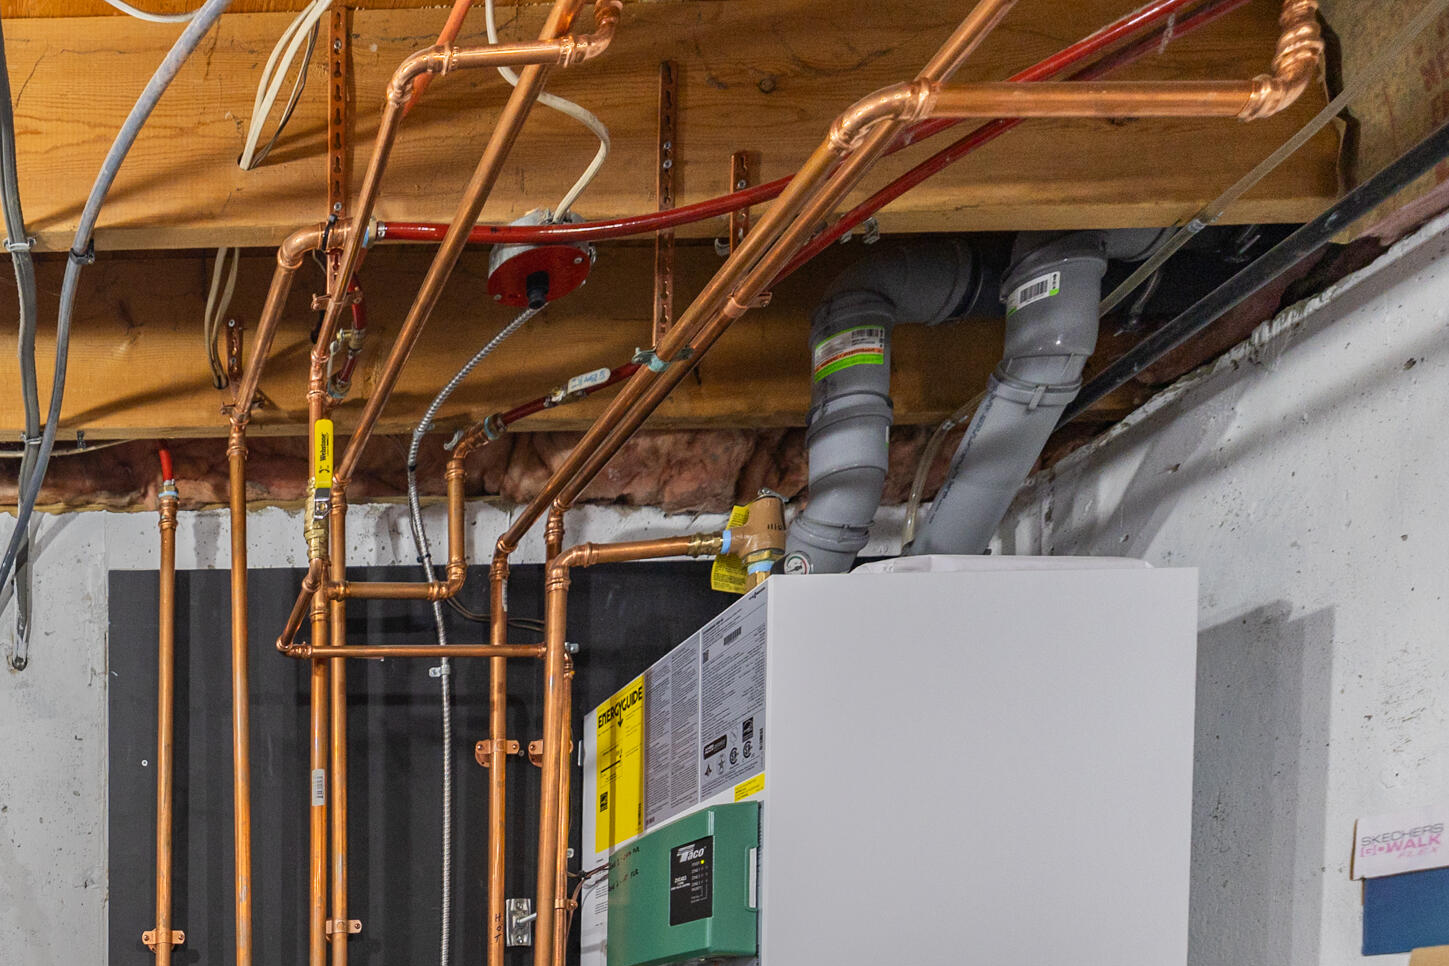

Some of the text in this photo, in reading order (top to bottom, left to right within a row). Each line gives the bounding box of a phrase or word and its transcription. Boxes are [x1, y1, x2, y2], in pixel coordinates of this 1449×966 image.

[598, 686, 643, 728] ENERGYGUIDE
[1360, 823, 1444, 847] SKECHERS
[677, 844, 705, 862] Taco
